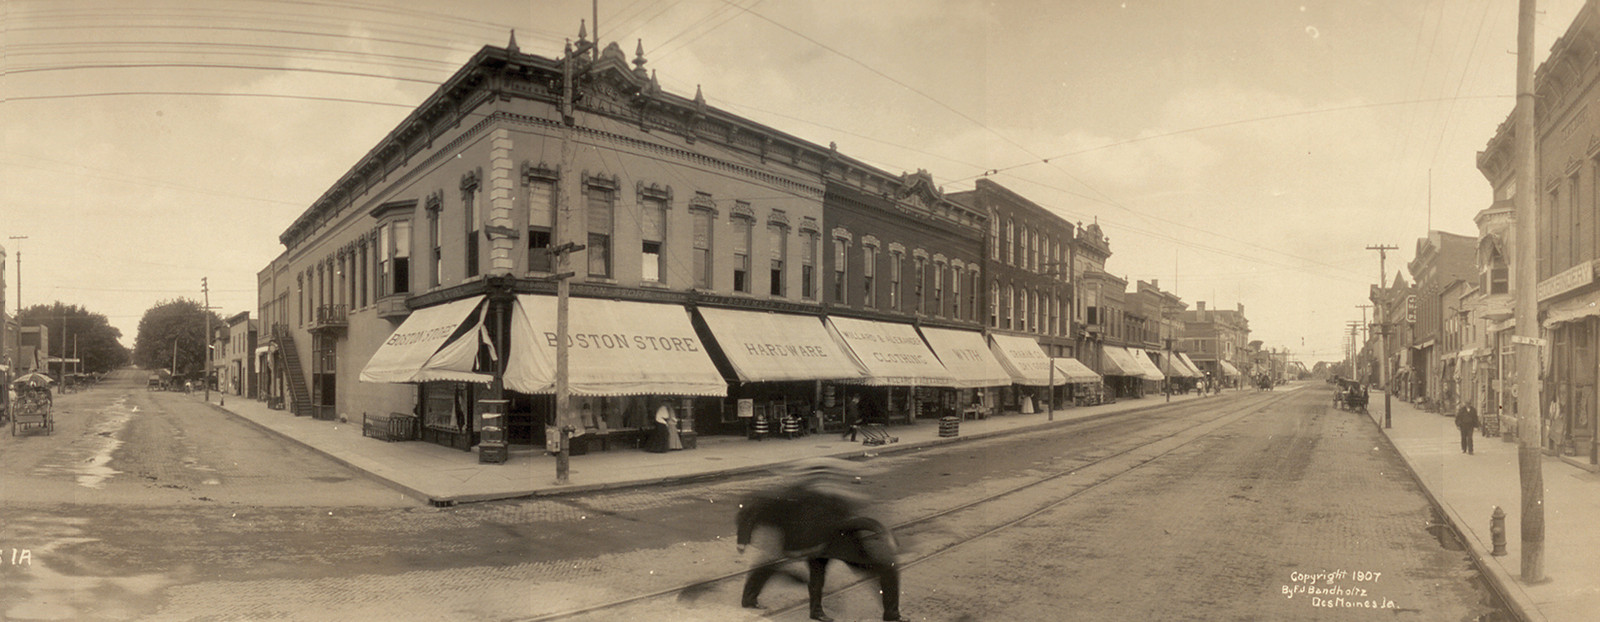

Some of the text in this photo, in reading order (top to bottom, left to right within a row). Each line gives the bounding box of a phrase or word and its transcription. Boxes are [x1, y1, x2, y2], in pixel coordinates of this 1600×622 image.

[568, 285, 607, 295] OSTON
[614, 289, 651, 299] STORE
[386, 324, 458, 346] BOSTON STORE
[841, 331, 877, 343] WILLARD
[885, 335, 921, 346] ALEXANDER
[634, 336, 698, 352] STORE
[744, 343, 828, 358] HARDWARE
[872, 352, 928, 365] CLOTHING
